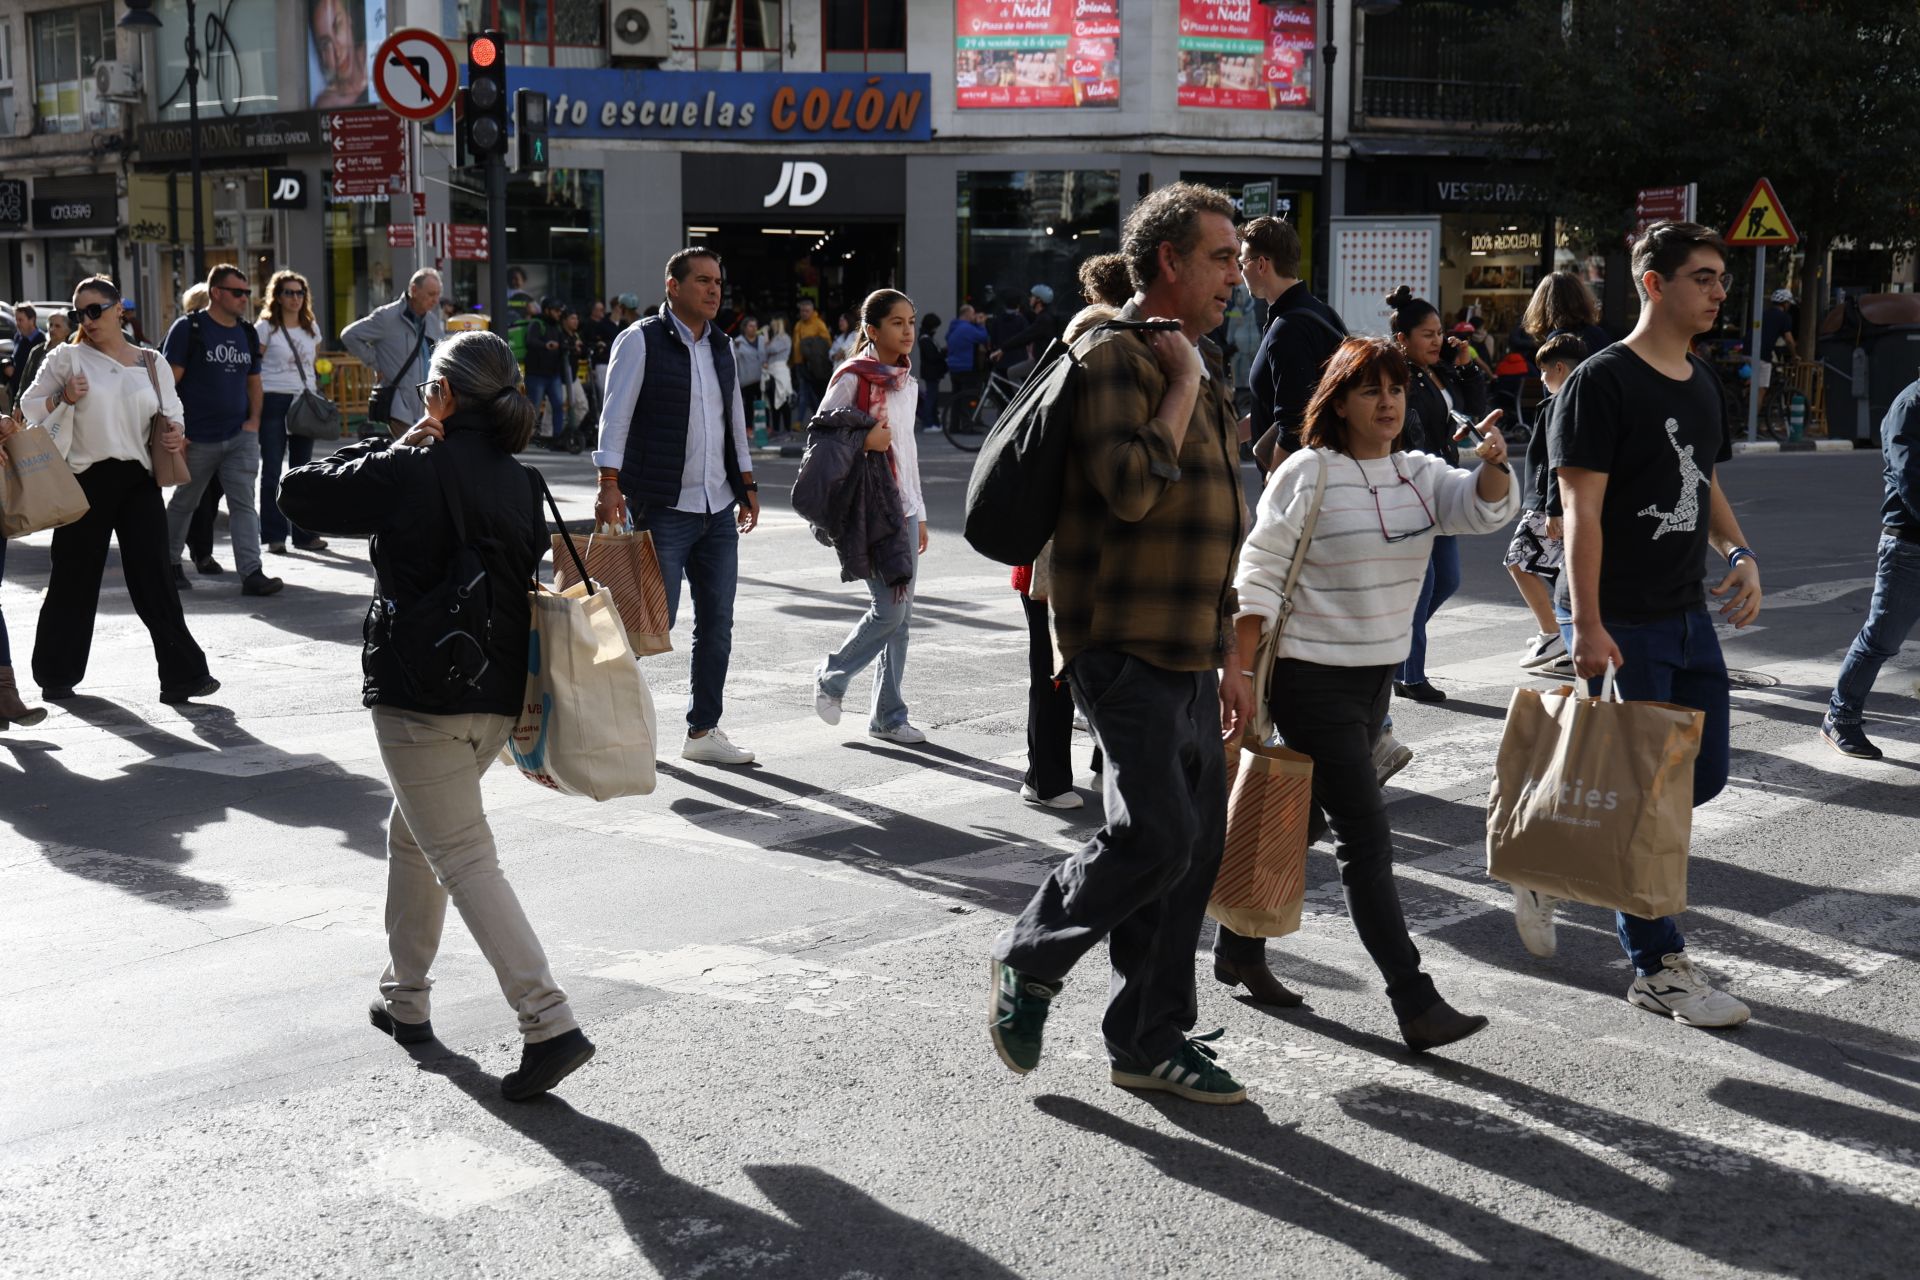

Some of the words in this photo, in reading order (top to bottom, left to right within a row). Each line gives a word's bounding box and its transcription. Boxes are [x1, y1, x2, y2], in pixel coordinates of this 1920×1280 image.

[1012, 3, 1052, 18] Nadal
[1217, 6, 1251, 22] Nadal
[981, 21, 1003, 31] Plaza
[1004, 21, 1015, 30] de
[1025, 20, 1048, 30] Reina
[1189, 22, 1210, 32] Plaza
[1210, 23, 1219, 32] de
[1228, 24, 1248, 34] Reina
[1072, 60, 1097, 74] Cuir
[1267, 66, 1288, 79] Cuir
[1086, 83, 1115, 97] Vidre
[1279, 90, 1302, 102] Vidre
[601, 91, 756, 128] escuelas
[770, 77, 923, 132] COLÓN
[144, 123, 241, 153] MICROBADING
[273, 177, 300, 200] JD
[763, 161, 828, 207] JD
[1471, 235, 1493, 250] 100%
[1494, 233, 1529, 250] RECYCLED
